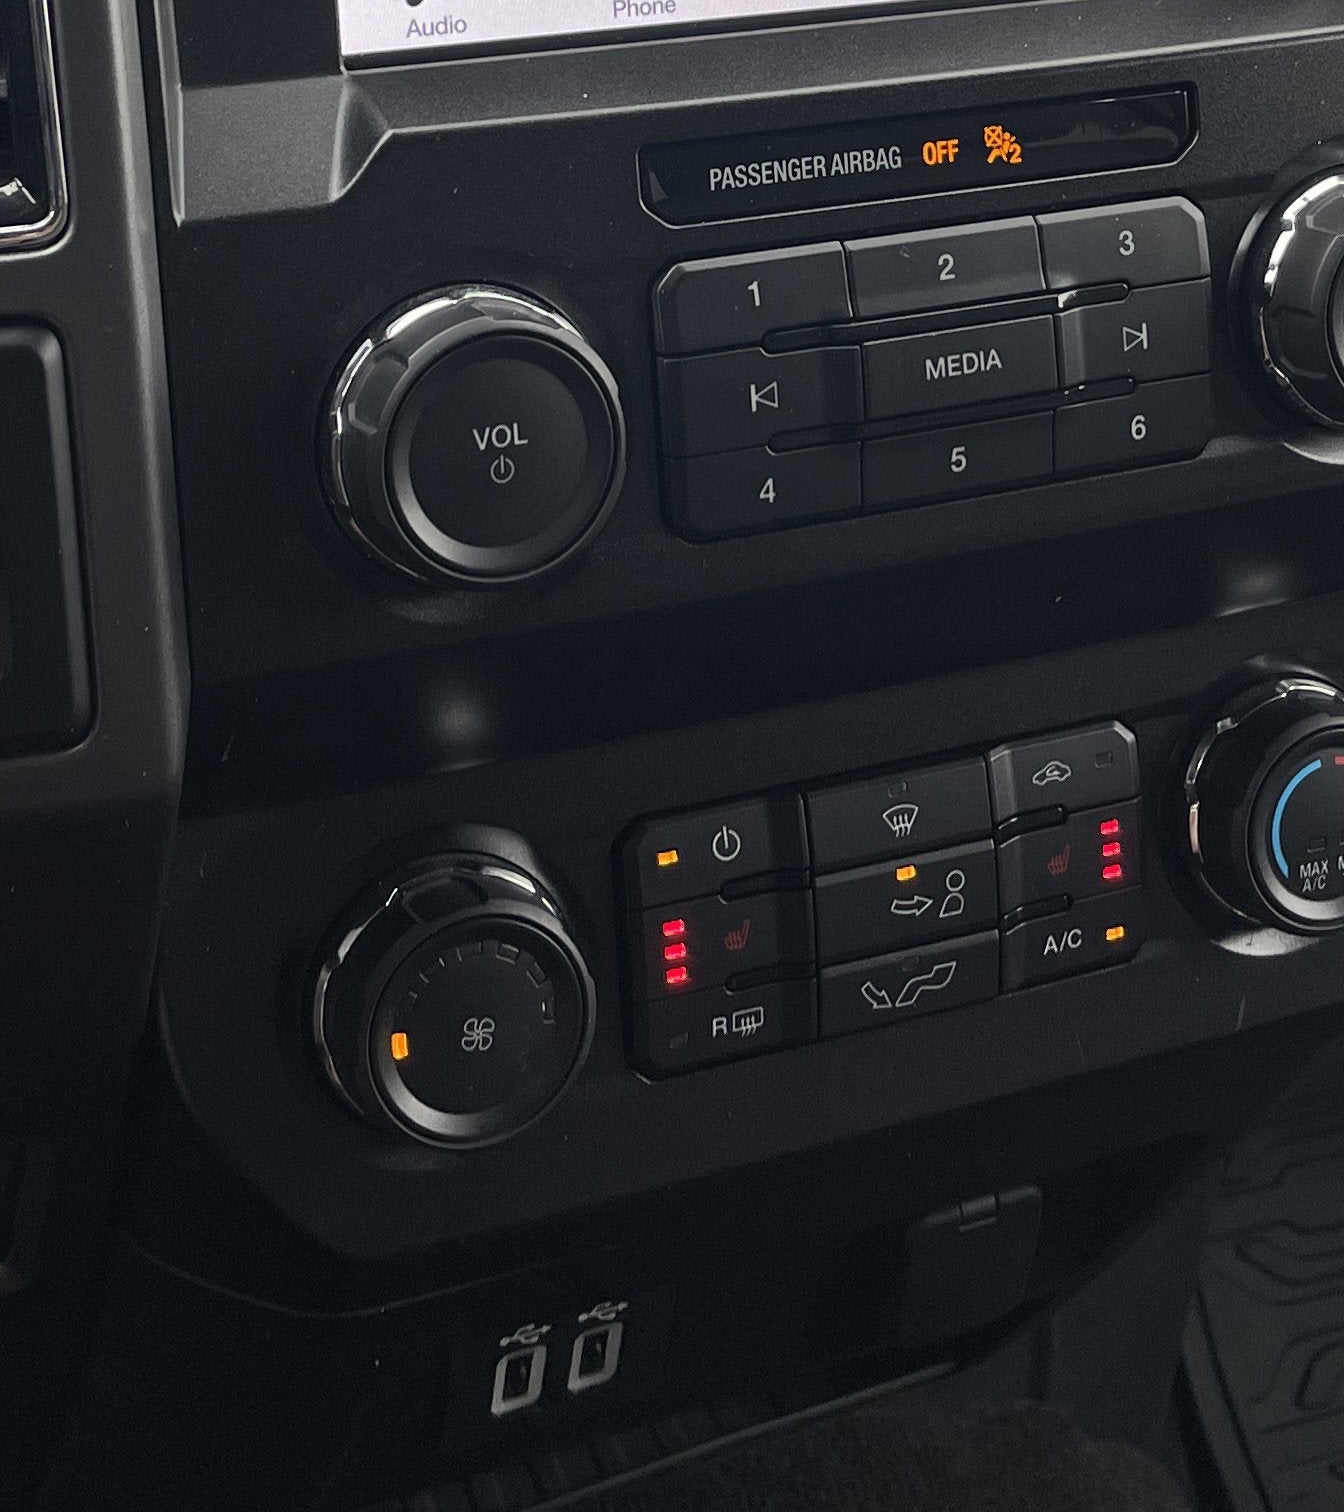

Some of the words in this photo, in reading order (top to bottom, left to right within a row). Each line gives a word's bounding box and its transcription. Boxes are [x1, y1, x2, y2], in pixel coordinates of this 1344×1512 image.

[405, 14, 468, 38] Audio
[709, 153, 826, 191] PASSENGER
[830, 145, 903, 178] AIRBAG
[921, 138, 960, 167] OFF
[1117, 230, 1135, 256] 3
[937, 253, 956, 281] 2
[747, 280, 762, 306] 1
[924, 348, 1003, 381] MEDIA
[472, 422, 529, 451] VOL
[1130, 414, 1147, 441] 6
[949, 445, 968, 474] 5
[758, 477, 777, 503] 4
[1299, 858, 1329, 879] MAX
[1302, 874, 1327, 893] A/C
[1043, 928, 1083, 956] A/C
[711, 1015, 728, 1038] R
